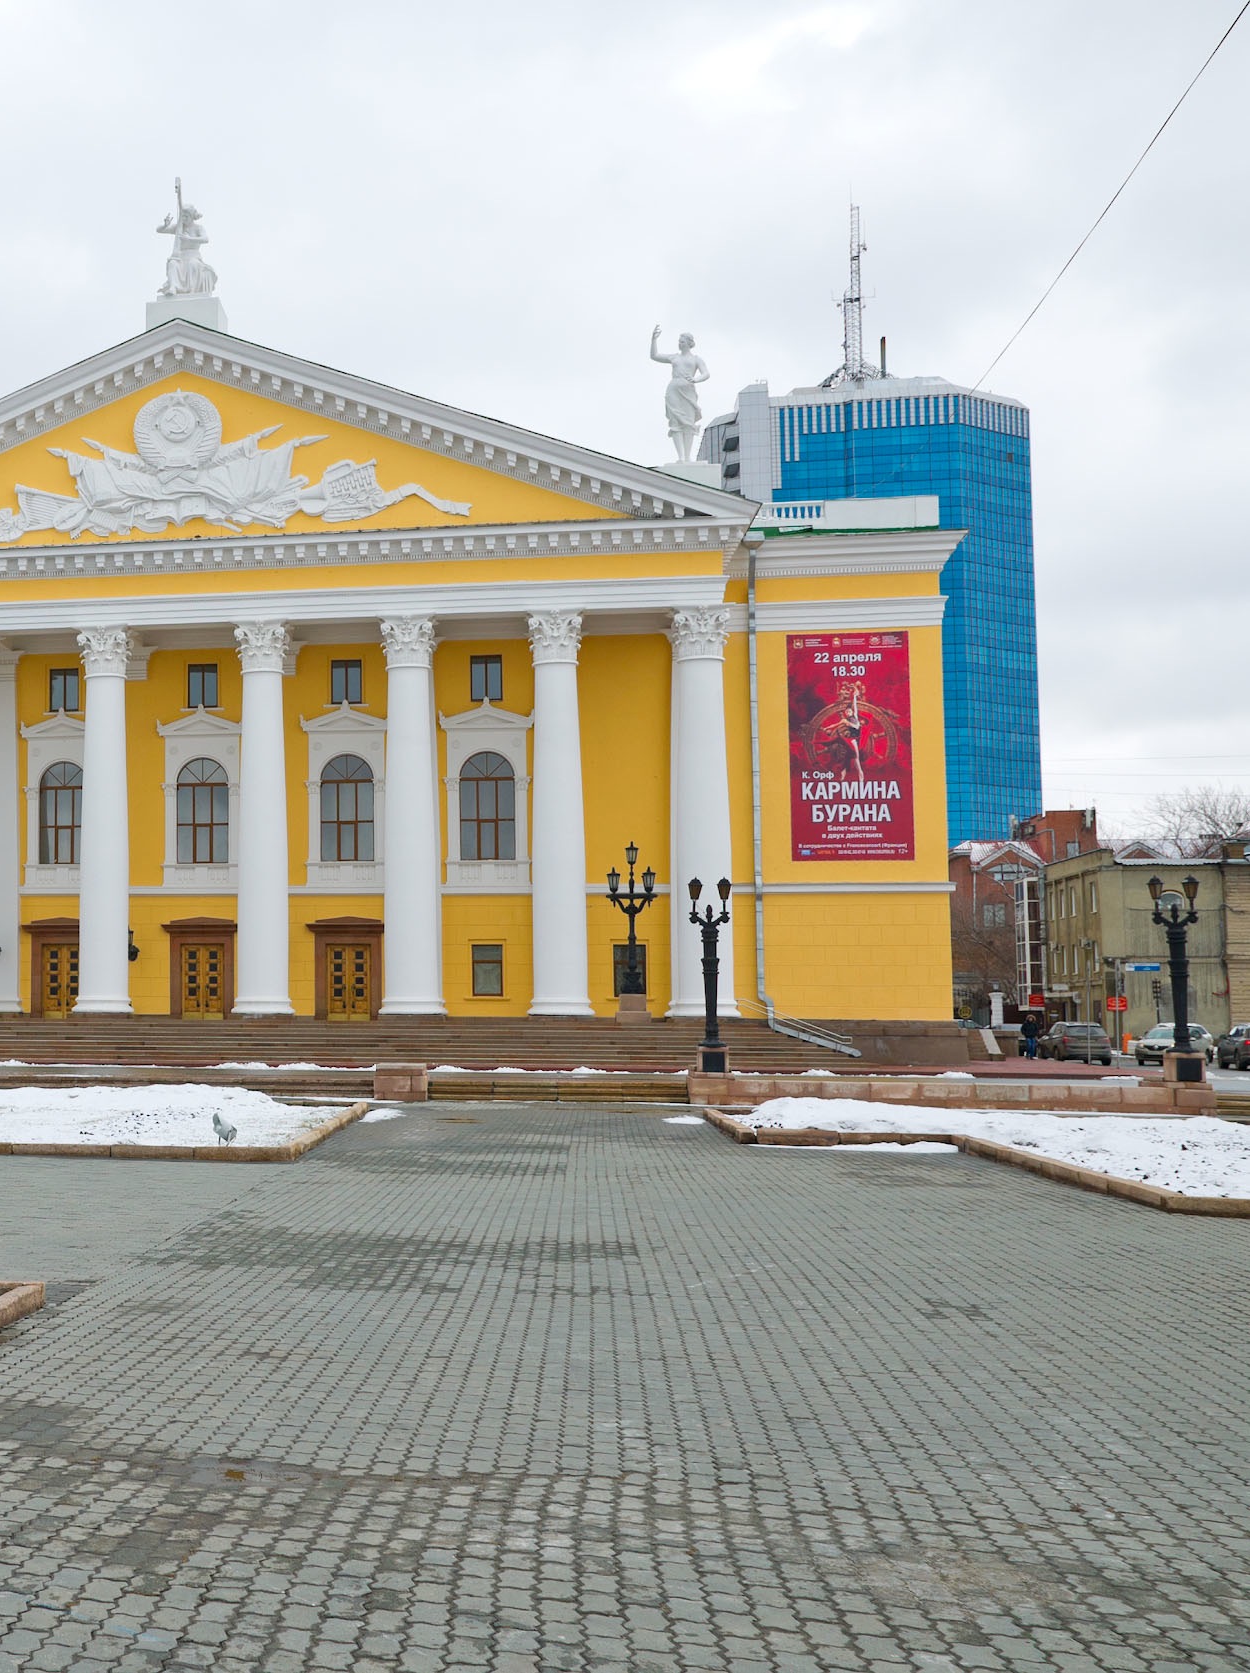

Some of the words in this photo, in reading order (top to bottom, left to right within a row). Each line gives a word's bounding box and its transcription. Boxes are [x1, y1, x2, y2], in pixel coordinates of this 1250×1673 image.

[814, 653, 829, 663] 22
[833, 653, 882, 664] апреля
[831, 665, 866, 677] 18.30
[802, 771, 810, 779] К.
[813, 771, 834, 780] Орф
[802, 781, 901, 800] КАРМИНА
[812, 804, 892, 823] БУРАНА
